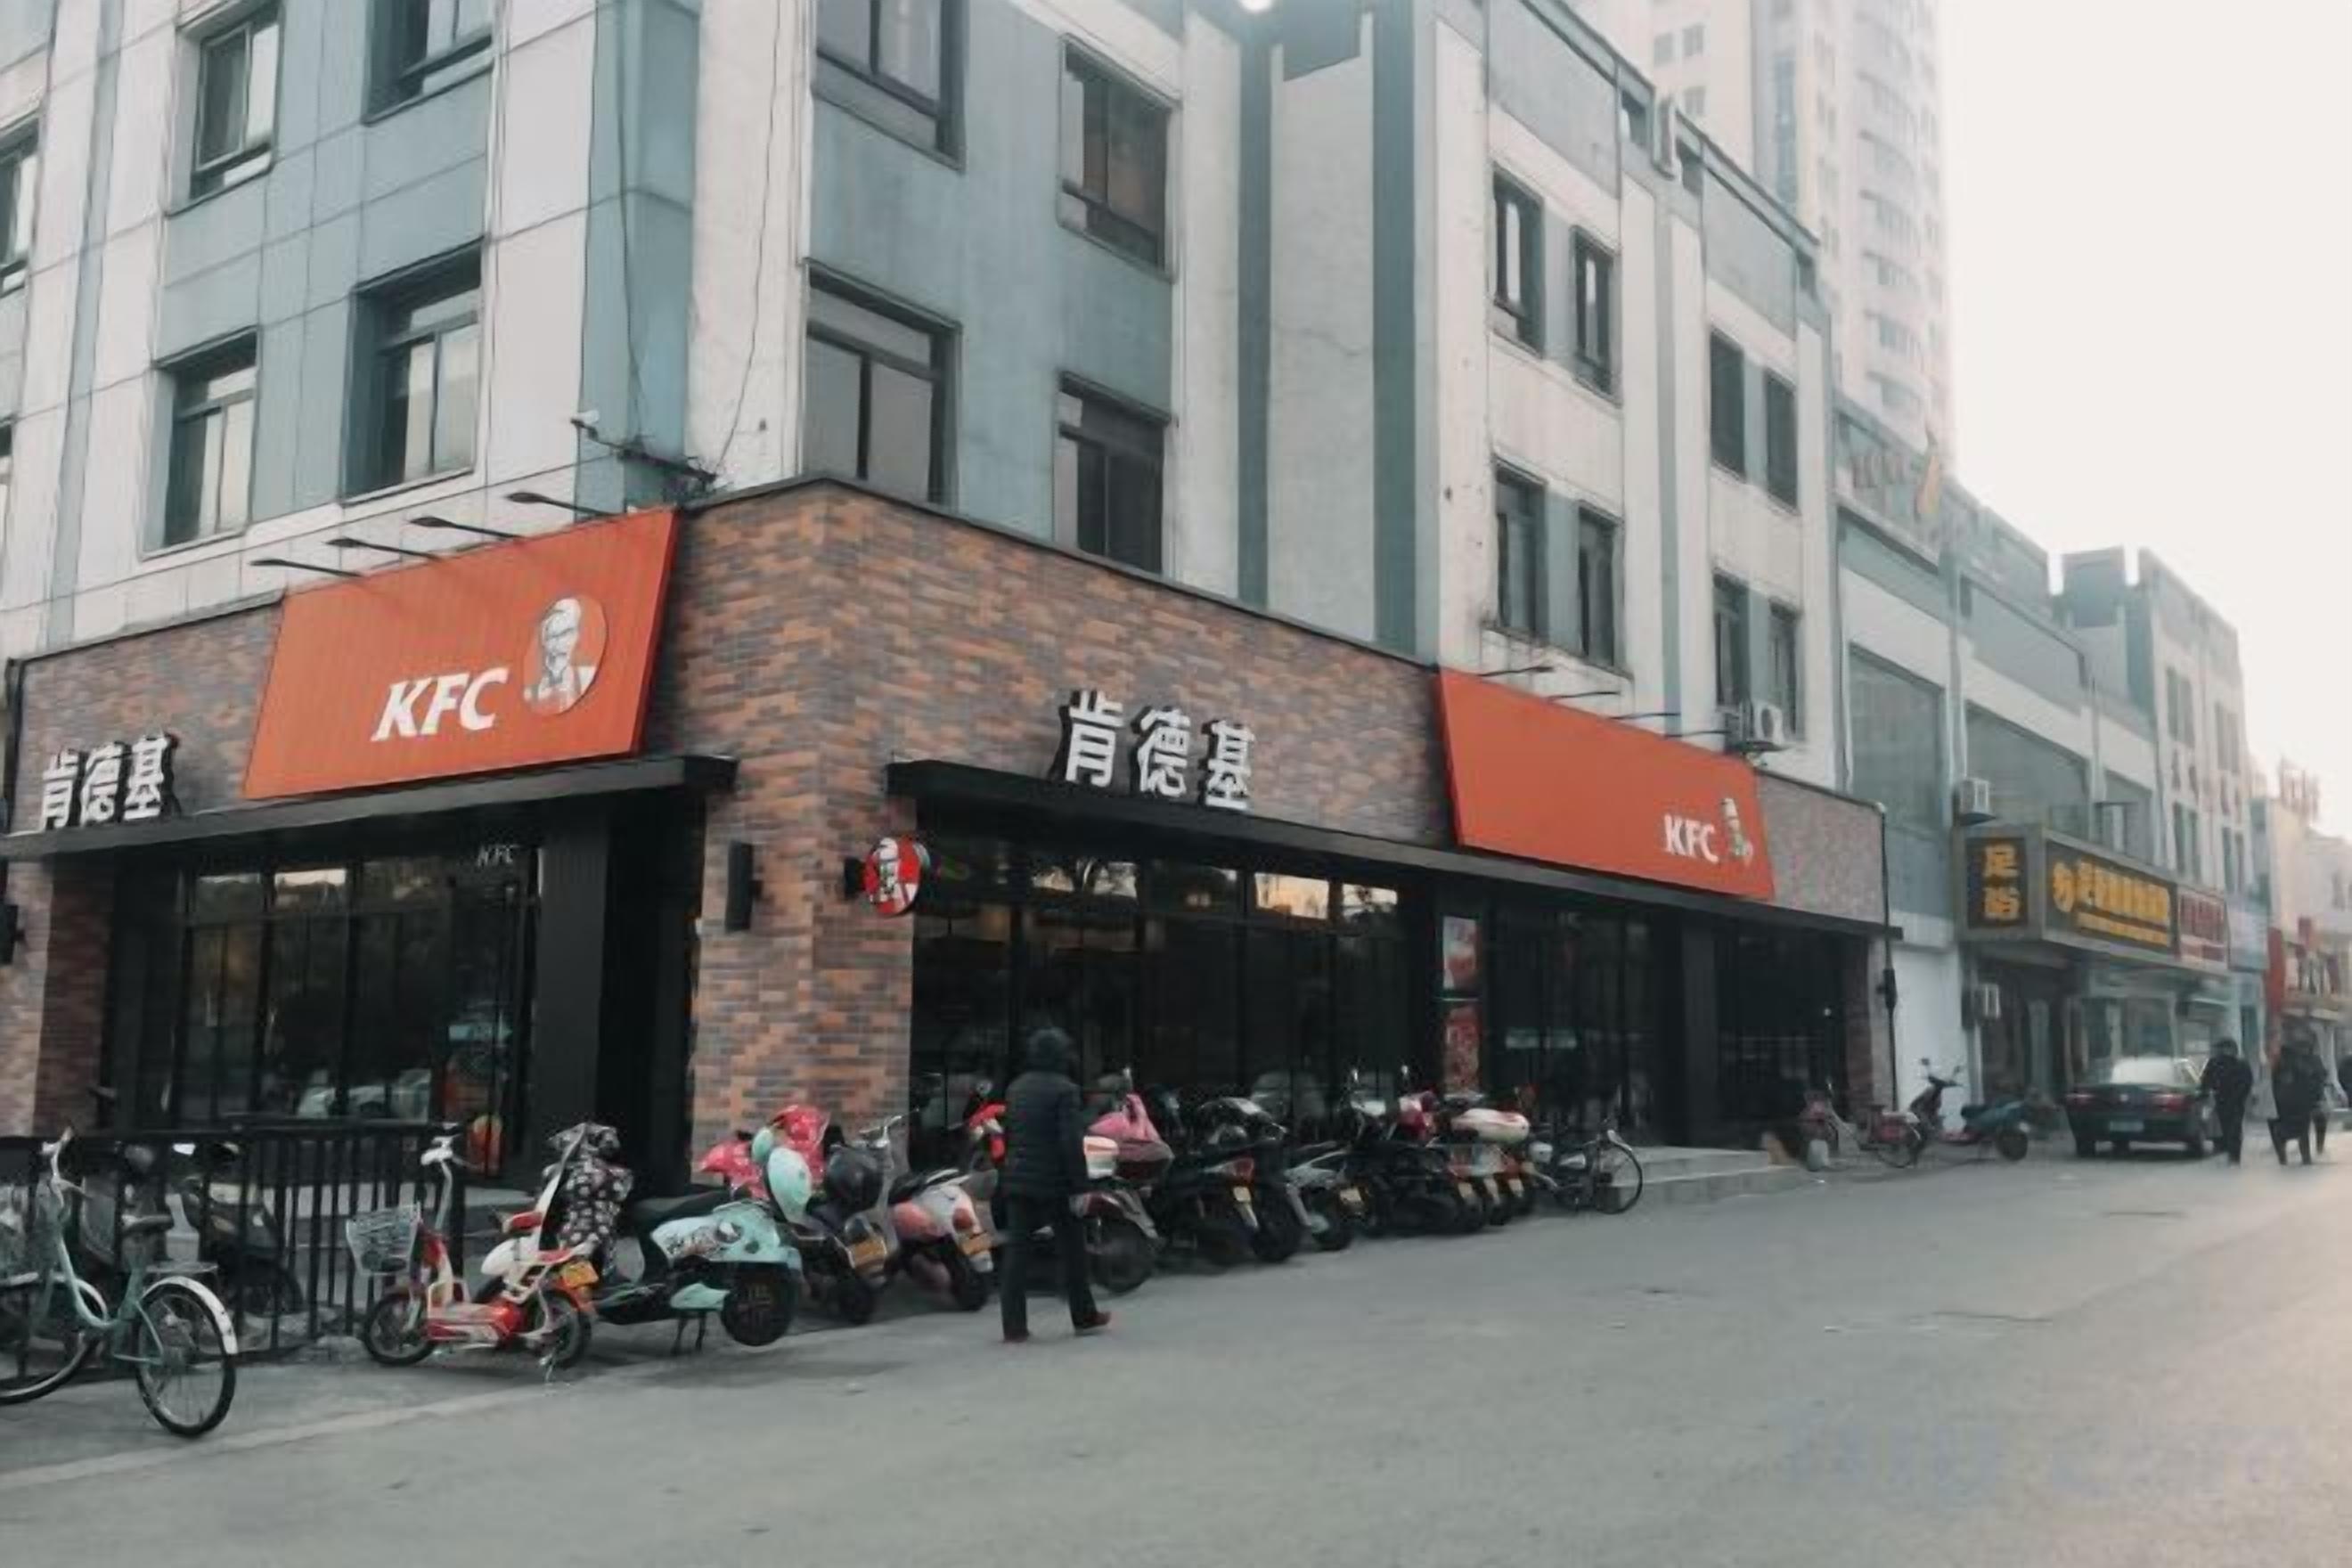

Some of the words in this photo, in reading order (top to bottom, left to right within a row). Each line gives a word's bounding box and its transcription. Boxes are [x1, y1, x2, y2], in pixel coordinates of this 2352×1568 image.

[371, 667, 510, 741] KFC
[40, 732, 169, 829] 肯德基
[1061, 689, 1254, 811] 肯德基
[1663, 814, 1720, 864] KFC
